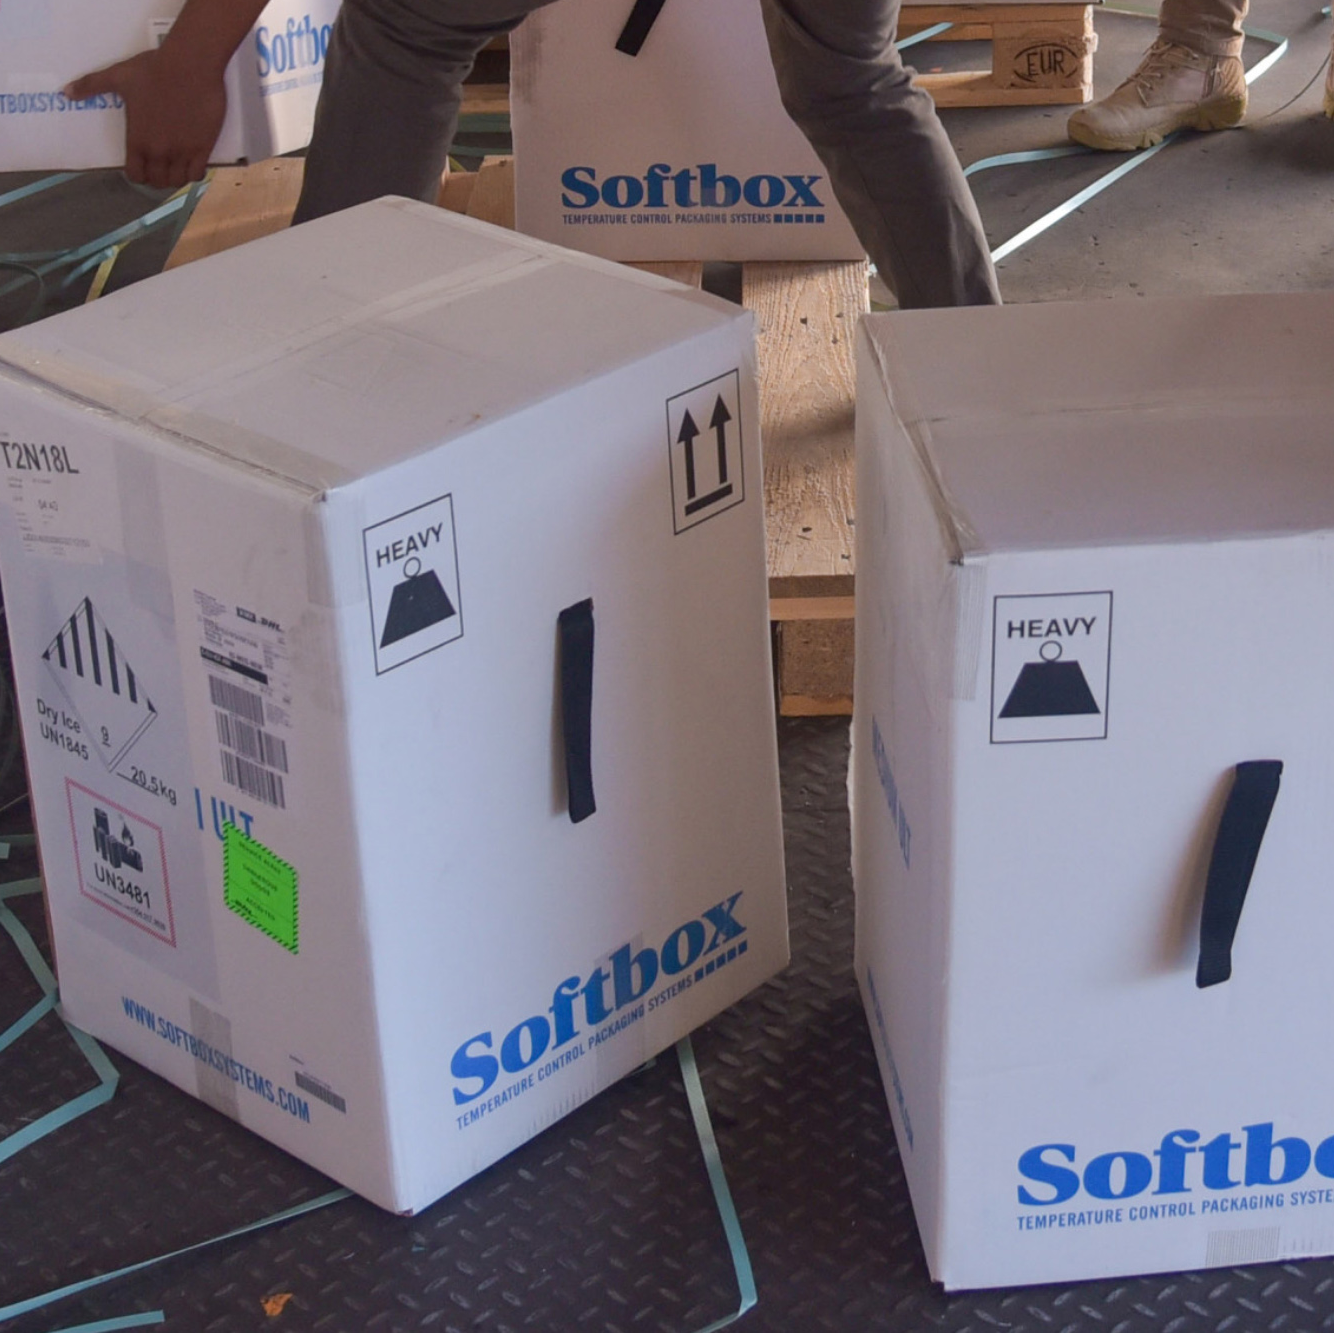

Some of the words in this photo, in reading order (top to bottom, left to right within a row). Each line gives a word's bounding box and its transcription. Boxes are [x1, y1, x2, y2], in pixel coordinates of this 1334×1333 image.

[255, 13, 334, 78] Softbo
[1027, 50, 1065, 78] EUR
[561, 163, 826, 209] Softbox
[563, 213, 628, 225] TEMPERATURE
[630, 213, 672, 225] CONTROL
[675, 213, 727, 224] PACKAGING
[730, 212, 772, 224] SYSTEMS
[375, 521, 443, 569] HEAVY
[1007, 615, 1097, 639] HEAVY
[36, 698, 59, 726] Dry
[61, 712, 82, 734] Ice
[100, 726, 110, 742] 9
[39, 722, 90, 761] UN1845
[93, 862, 152, 910] UN3481
[450, 890, 748, 1106] Softbox
[121, 996, 311, 1124] WWW.SOFTBOXSYSTEMS.COM
[457, 1073, 535, 1130] TEMPERATURE
[537, 1043, 586, 1082] CONTROL
[588, 1006, 645, 1051] PACKAGING
[648, 974, 693, 1012] SYSTEMS
[1017, 1207, 1124, 1231] TEMPERATURE
[1128, 1201, 1197, 1222] CONTROL
[1201, 1192, 1285, 1215] PACKAGING
